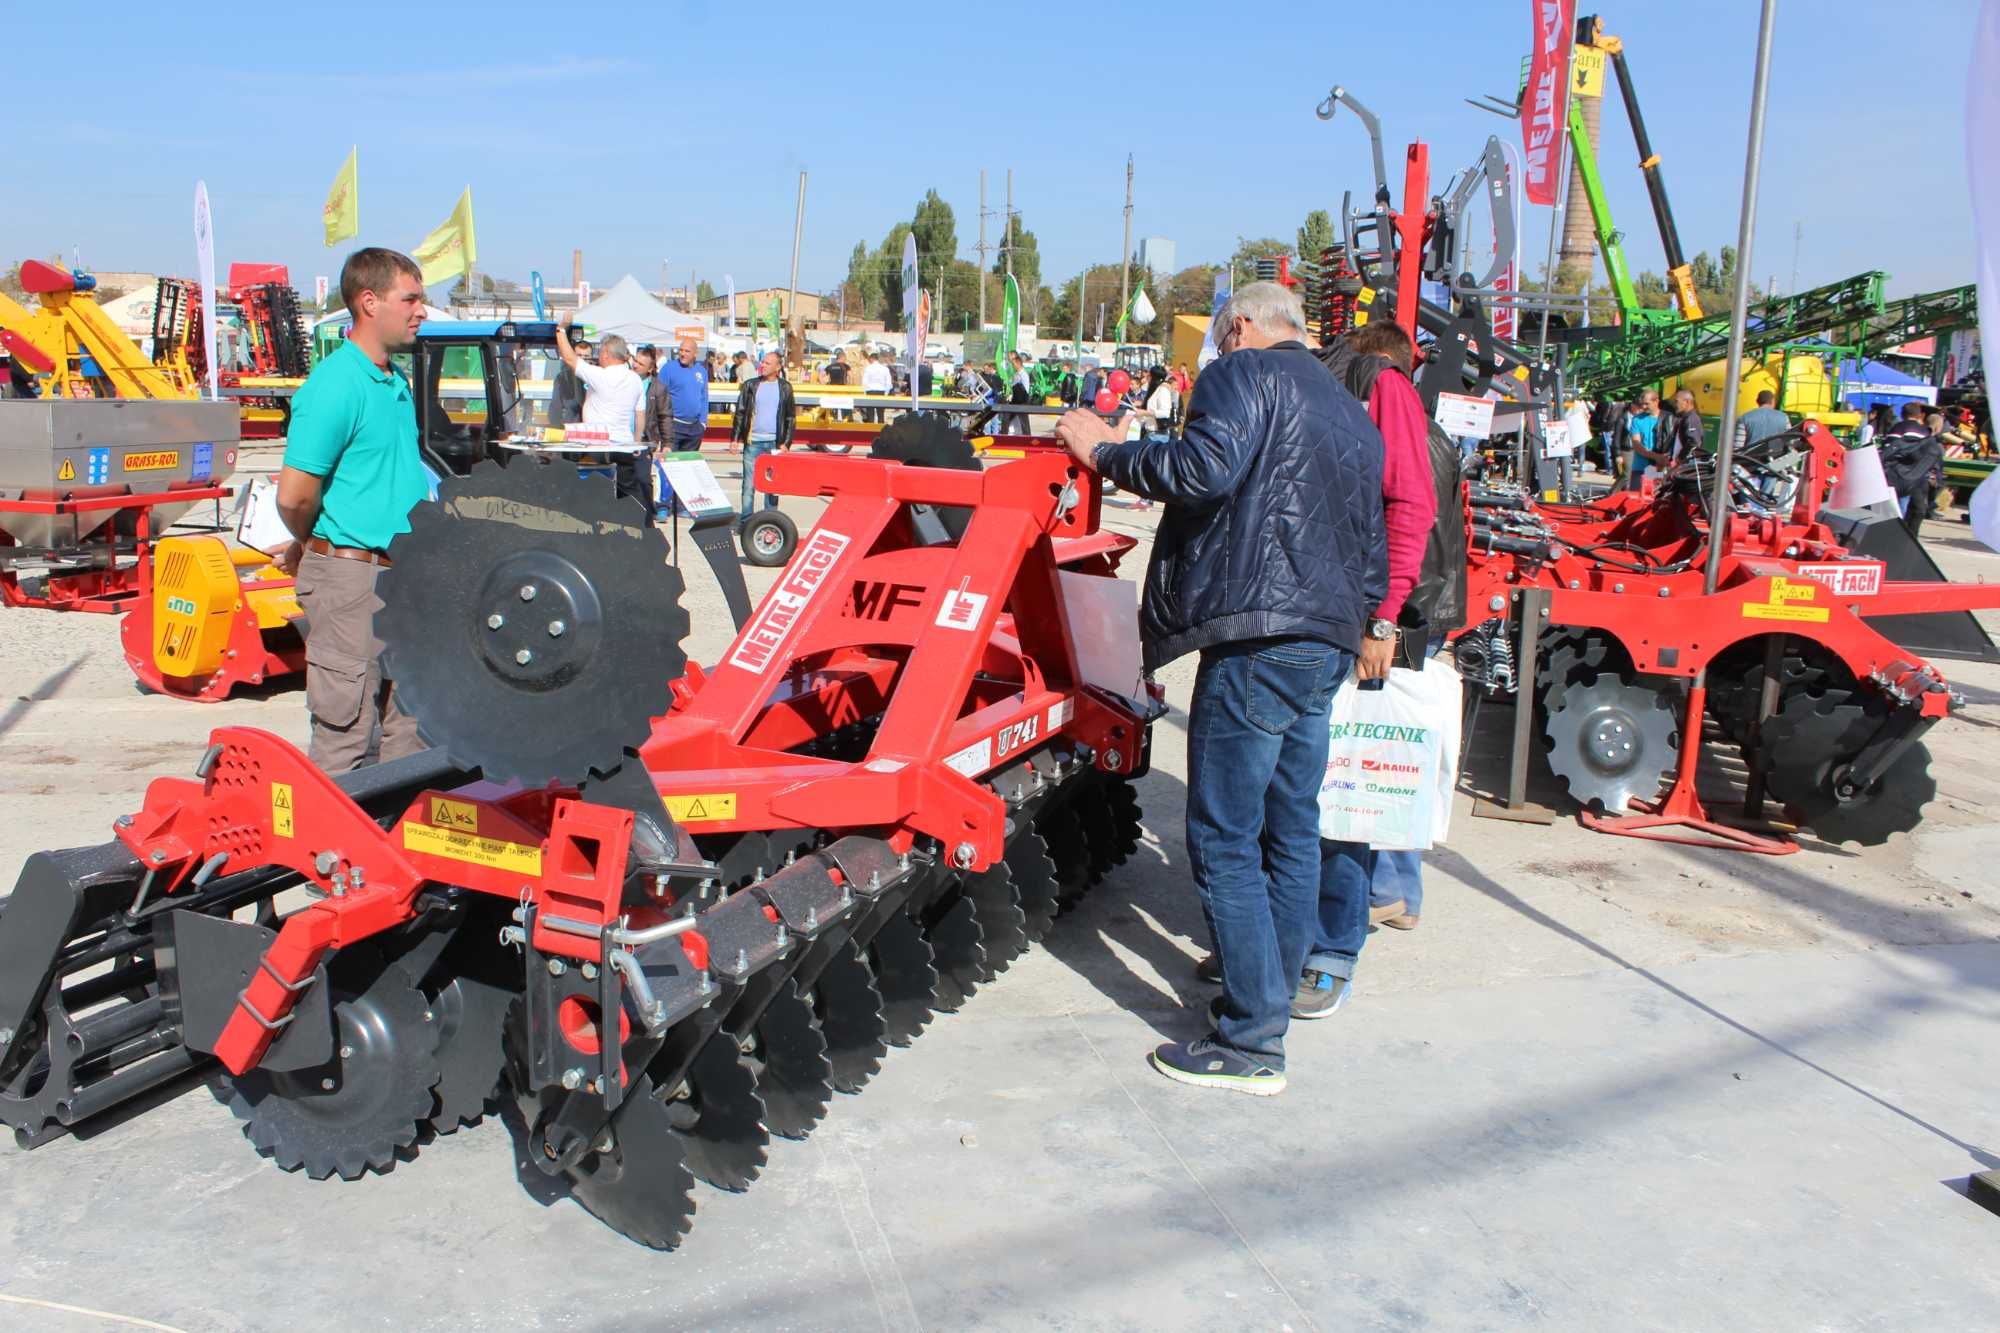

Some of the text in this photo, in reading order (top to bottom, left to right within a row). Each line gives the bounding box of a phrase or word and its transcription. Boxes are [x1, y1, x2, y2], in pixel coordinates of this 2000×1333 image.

[125, 454, 177, 469] GRASS-ROL
[736, 534, 844, 668] METAL-FACH
[841, 579, 927, 622] MF
[948, 584, 976, 624] MF
[1352, 723, 1426, 743] TECHNIK
